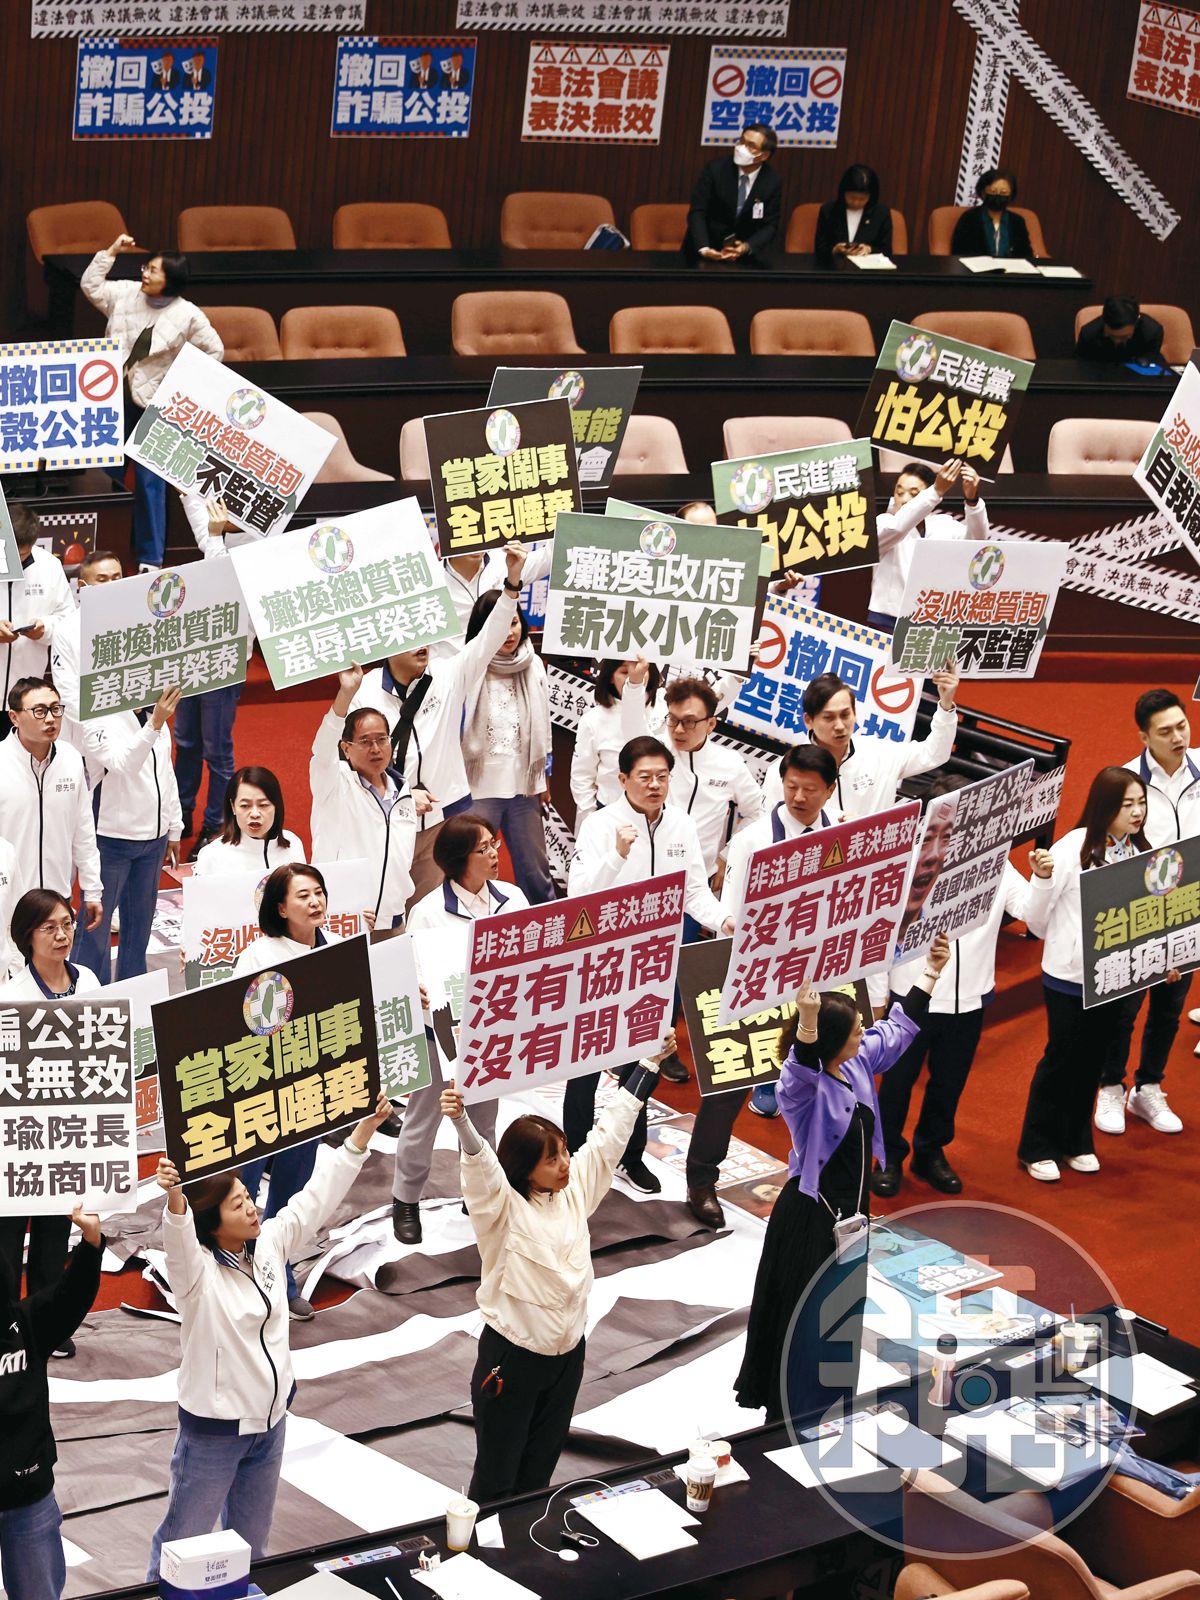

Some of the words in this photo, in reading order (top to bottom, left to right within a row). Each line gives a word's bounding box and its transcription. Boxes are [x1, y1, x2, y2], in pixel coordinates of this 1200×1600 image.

[34, 10, 95, 27] 違法會議
[101, 6, 162, 23] 決議無效
[169, 6, 229, 22] 違法會議
[236, 5, 296, 21] 決議無效
[302, 4, 363, 20] 違法會議
[459, 2, 519, 18] 違法會議
[526, 3, 586, 20] 決議無效
[592, 4, 652, 22] 違法會議
[659, 7, 719, 24] 決議無效
[725, 9, 785, 27] 違法會議
[80, 55, 147, 90] 撤回
[339, 54, 407, 88] 撤回
[531, 66, 659, 100] 違法會議
[746, 65, 810, 98] 撤回
[980, 53, 1000, 113] 違法會議
[78, 92, 213, 127] 詐騙公投
[337, 90, 470, 125] 詐騙公投
[528, 101, 655, 136] 表決無效
[0, 363, 77, 406] 撤回
[932, 348, 1017, 403] 民進黨
[160, 390, 305, 496] 沒收總質詢
[871, 381, 1008, 462] 怕公投
[139, 420, 288, 537] 護航不監督
[440, 443, 570, 502] 當家鬧事
[773, 454, 861, 503] 民進黨
[260, 551, 434, 634] 癱瘓總質詢
[564, 545, 746, 603] 癱瘓政府
[1103, 567, 1170, 600] 決議無效
[92, 600, 240, 672] 癱瘓總質詢
[275, 595, 448, 679] 羞辱卓榮泰
[560, 596, 739, 662] 薪水小偷
[913, 590, 1048, 624] 沒收總質詢
[90, 643, 239, 713] 羞辱卓榮泰
[786, 631, 875, 703] 撤回
[899, 628, 1037, 673] 護航不監督
[956, 766, 1033, 828] 詐騙公投
[750, 843, 822, 895] 非法會議
[848, 814, 918, 862] 表決無效
[944, 805, 1021, 868] 表決無效
[741, 860, 908, 955] 沒有協商
[930, 851, 1007, 908] 韓國瑜院長
[475, 913, 566, 966] 非法會議
[597, 886, 683, 933] 表決無效
[904, 886, 997, 953] 說好的協商呢
[468, 934, 675, 1029] 沒有協商
[729, 917, 898, 1011] 沒有開會
[176, 998, 363, 1113] 當家鬧事
[463, 993, 670, 1088] 沒有開會
[181, 1057, 371, 1173] 全民唾棄
